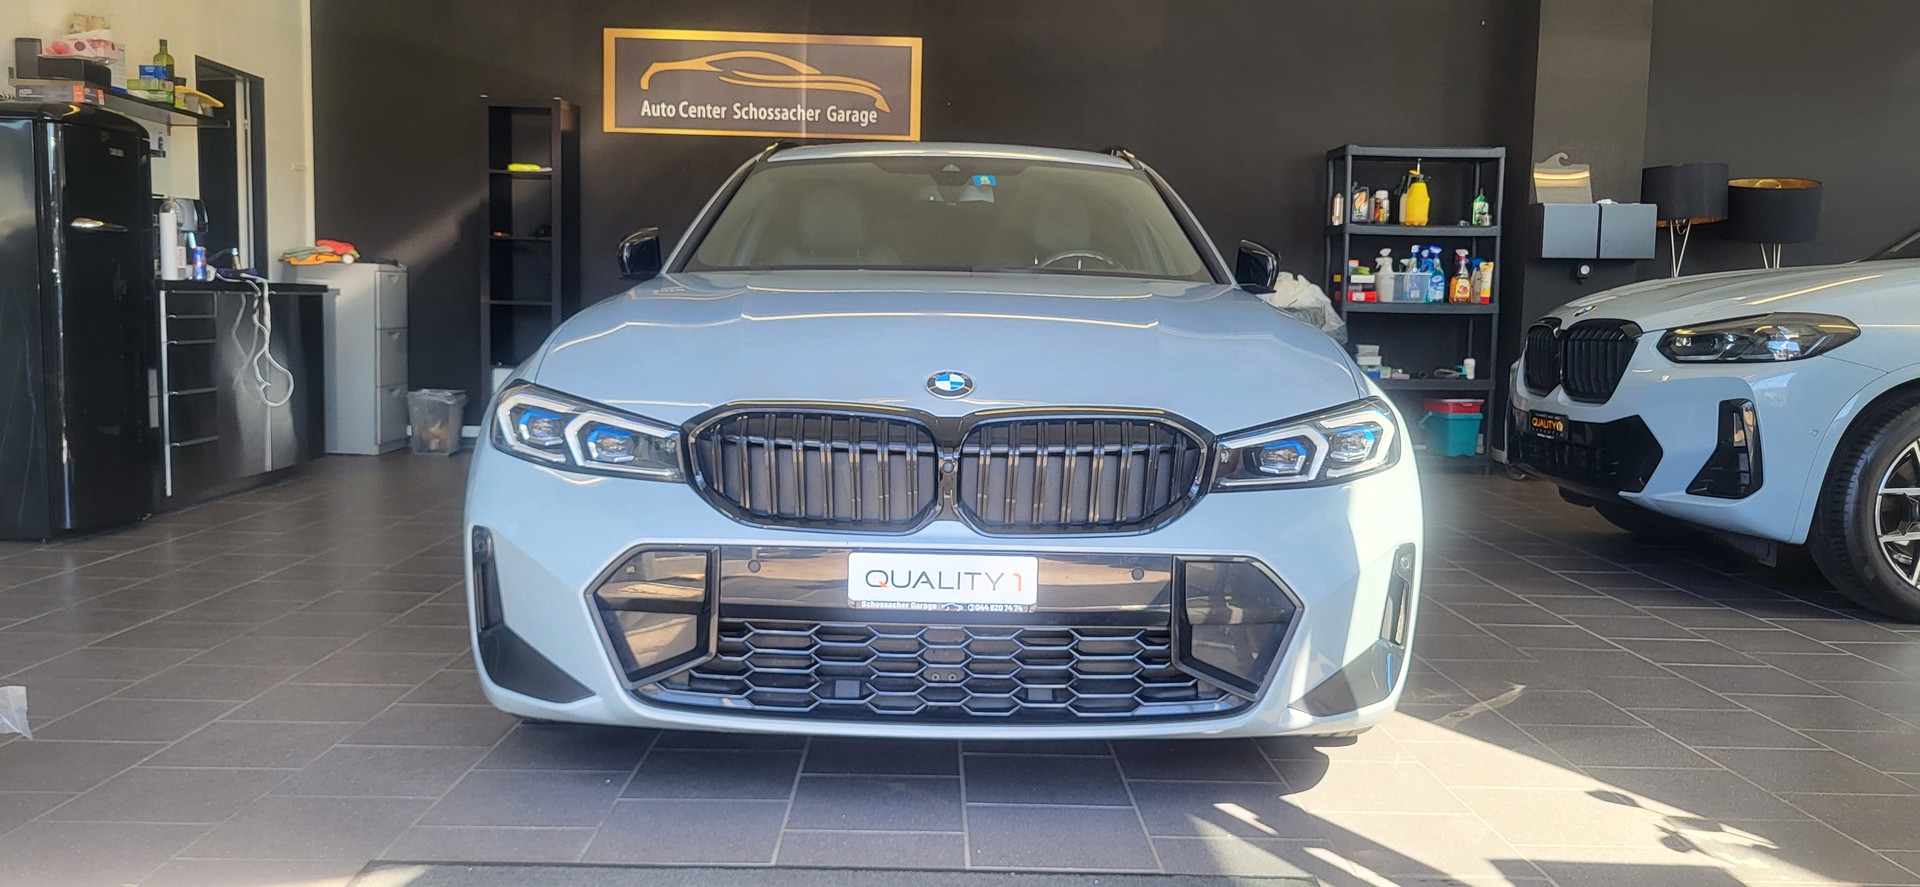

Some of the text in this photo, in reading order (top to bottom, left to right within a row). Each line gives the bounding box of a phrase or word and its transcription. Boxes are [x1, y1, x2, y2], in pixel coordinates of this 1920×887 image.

[640, 99, 878, 127] Auto Center Schossacher Garage
[1532, 417, 1557, 429] QUALITY
[865, 569, 1022, 592] QUALITY 1
[861, 600, 937, 611] Schossacher Garage
